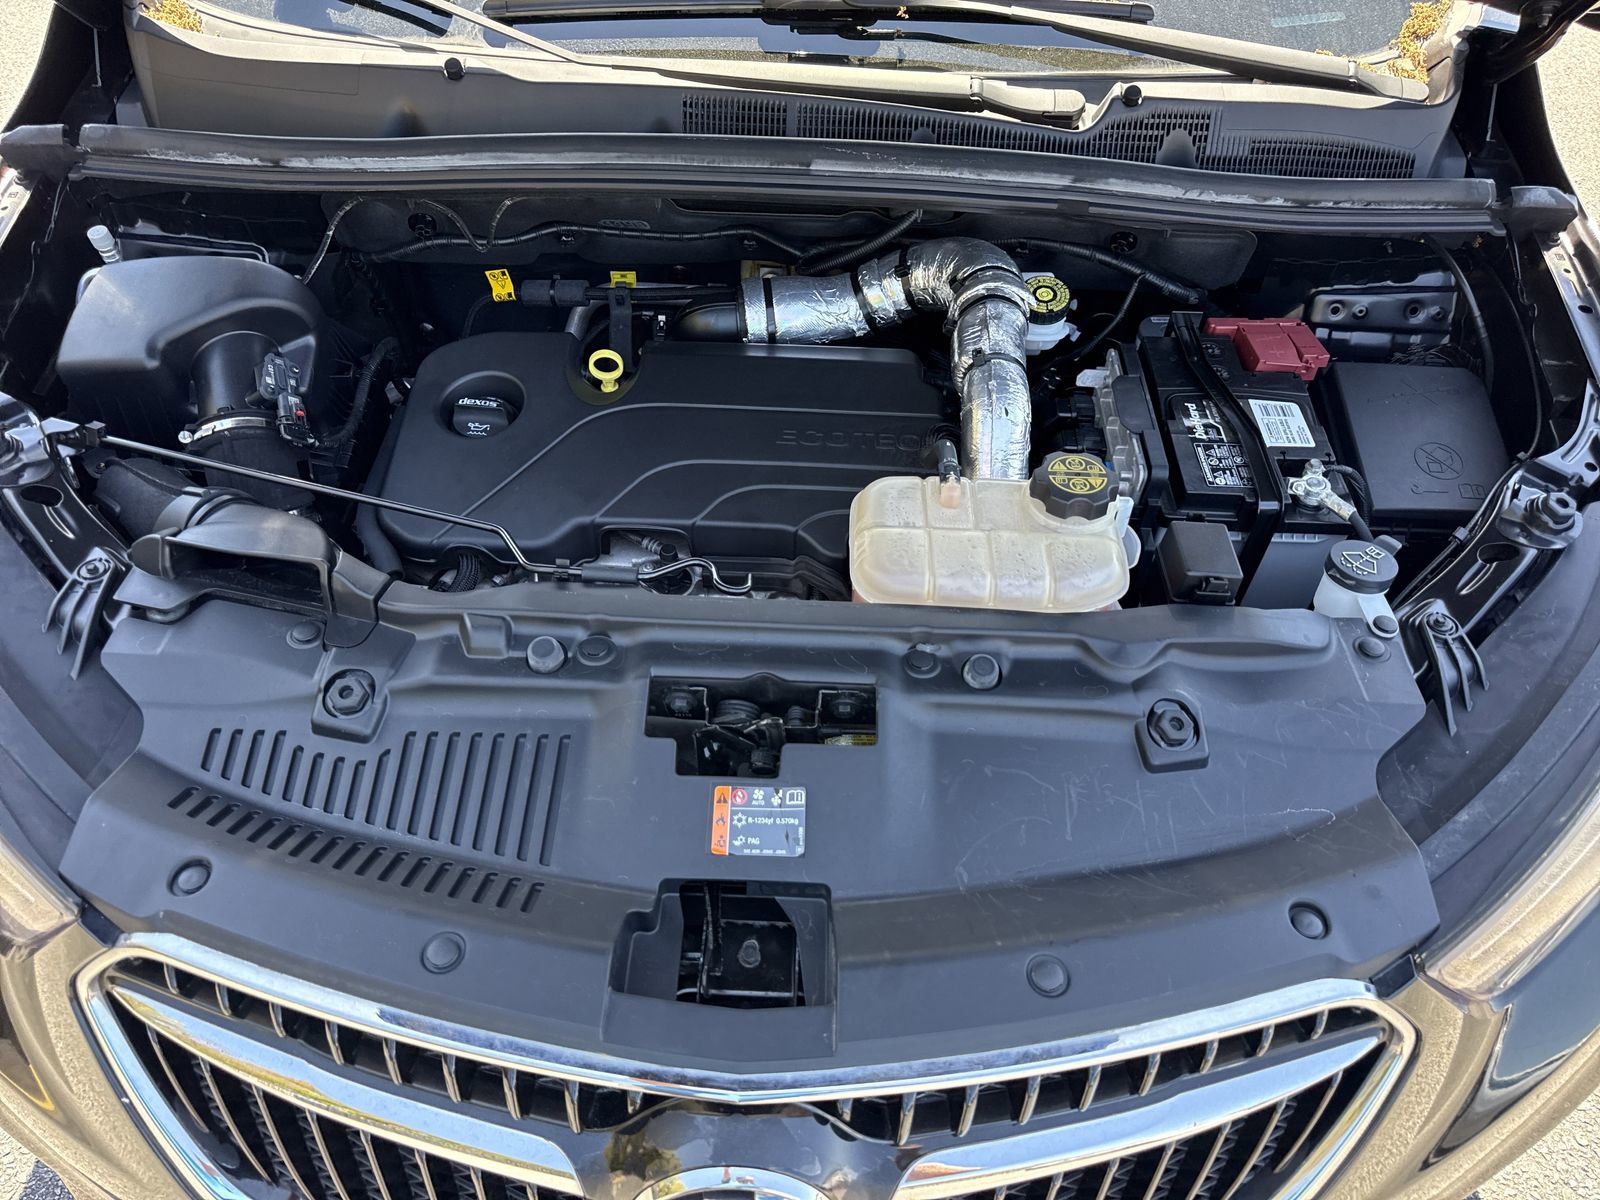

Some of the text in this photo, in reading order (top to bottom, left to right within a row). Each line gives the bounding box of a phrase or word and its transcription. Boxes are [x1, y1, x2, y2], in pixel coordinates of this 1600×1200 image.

[458, 397, 498, 407] dexos
[1184, 402, 1206, 439] DieHard
[776, 429, 921, 451] ECOTEC
[747, 837, 760, 845] PAG
